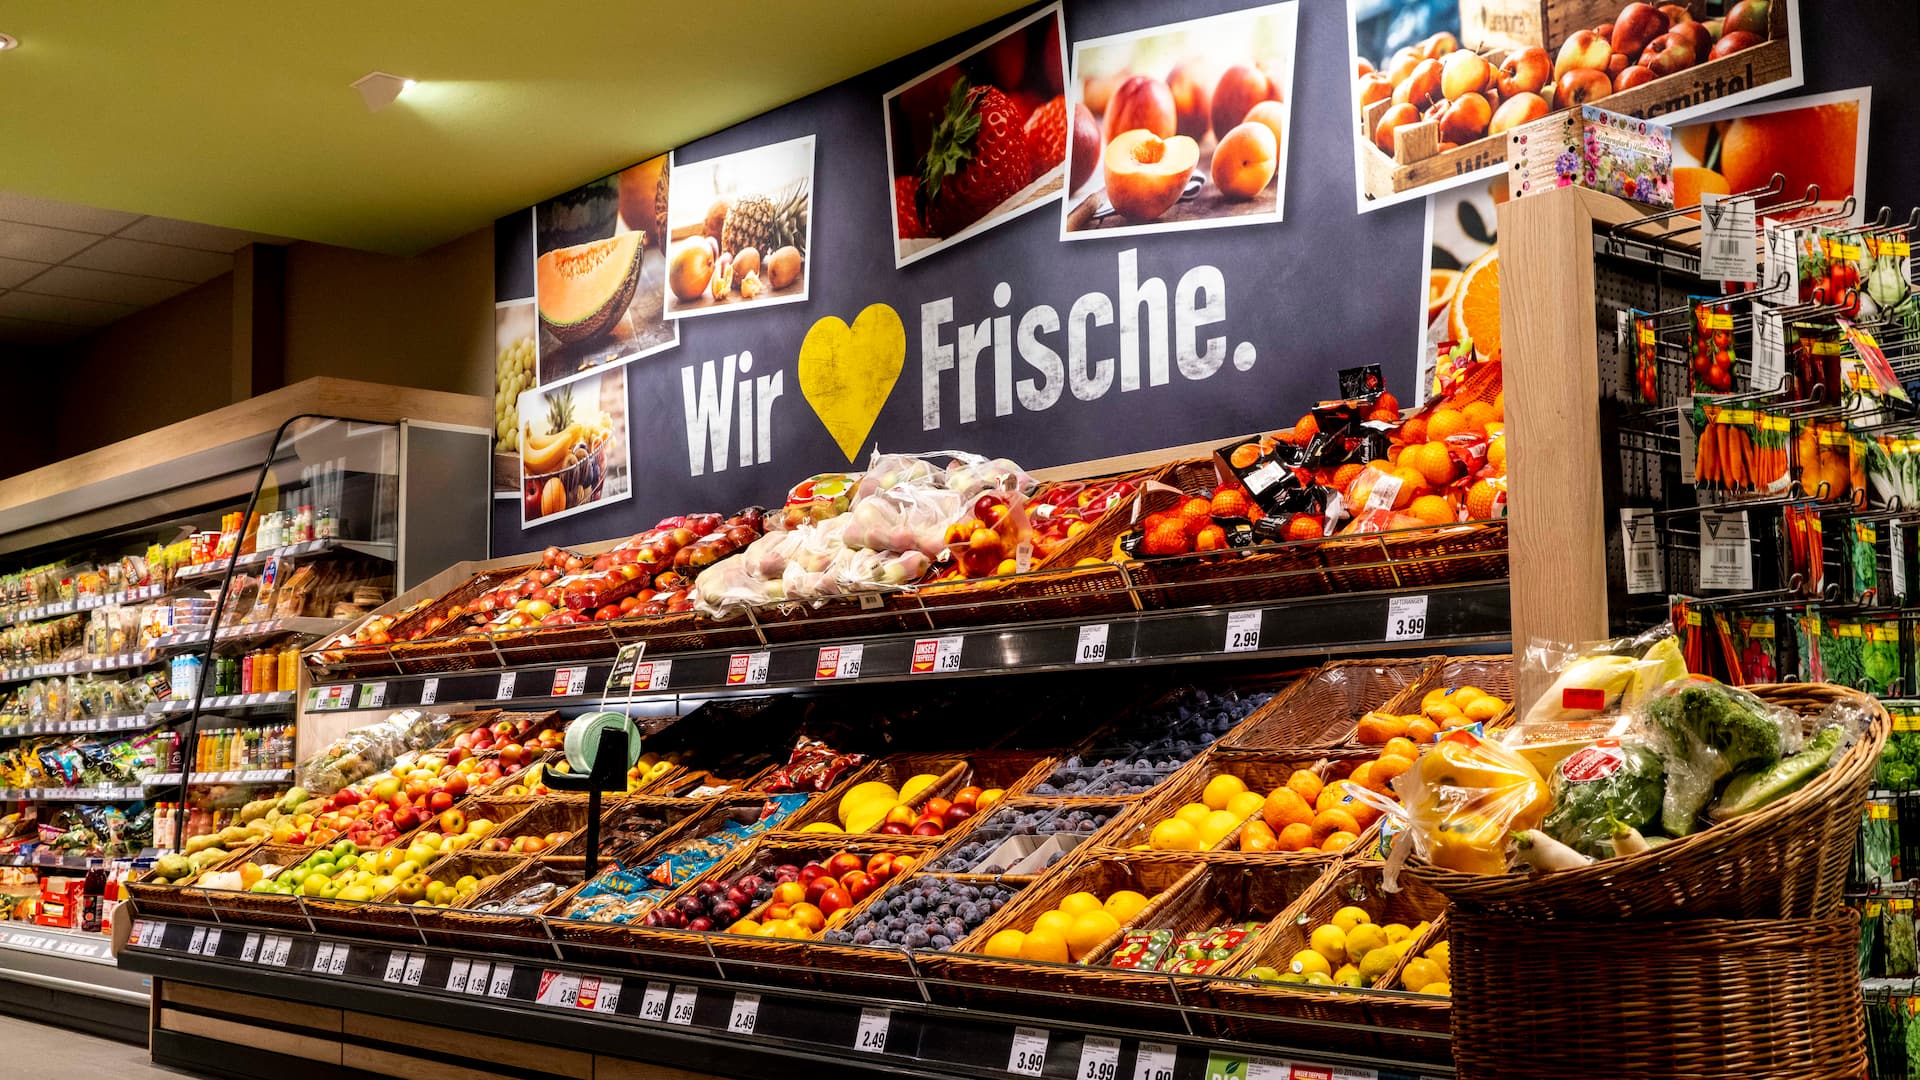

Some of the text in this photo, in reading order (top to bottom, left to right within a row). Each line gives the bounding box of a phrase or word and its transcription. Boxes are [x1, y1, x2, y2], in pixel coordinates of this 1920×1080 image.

[681, 248, 1257, 477] Wir Frische.
[1396, 617, 1424, 636] 3.99
[1233, 631, 1258, 648] 2.99
[916, 643, 936, 654] UNSER
[1083, 644, 1105, 659] 0.99
[843, 661, 860, 675] 1.29
[942, 654, 960, 669] 1.39
[752, 668, 767, 681] 1.99
[388, 967, 401, 980] 2.49
[407, 969, 421, 982] 2.49
[452, 976, 466, 989] 1.49
[471, 978, 485, 991] 1.99
[493, 981, 508, 995] 2.99
[560, 989, 576, 1004] 2.49
[601, 996, 616, 1010] 1.49
[646, 1001, 664, 1016] 2.49
[675, 1005, 693, 1019] 2.99
[735, 1013, 755, 1029] 2.49
[862, 1031, 885, 1048] 2.49
[1017, 1051, 1043, 1071] 3.99
[1087, 1061, 1115, 1080] 3.99
